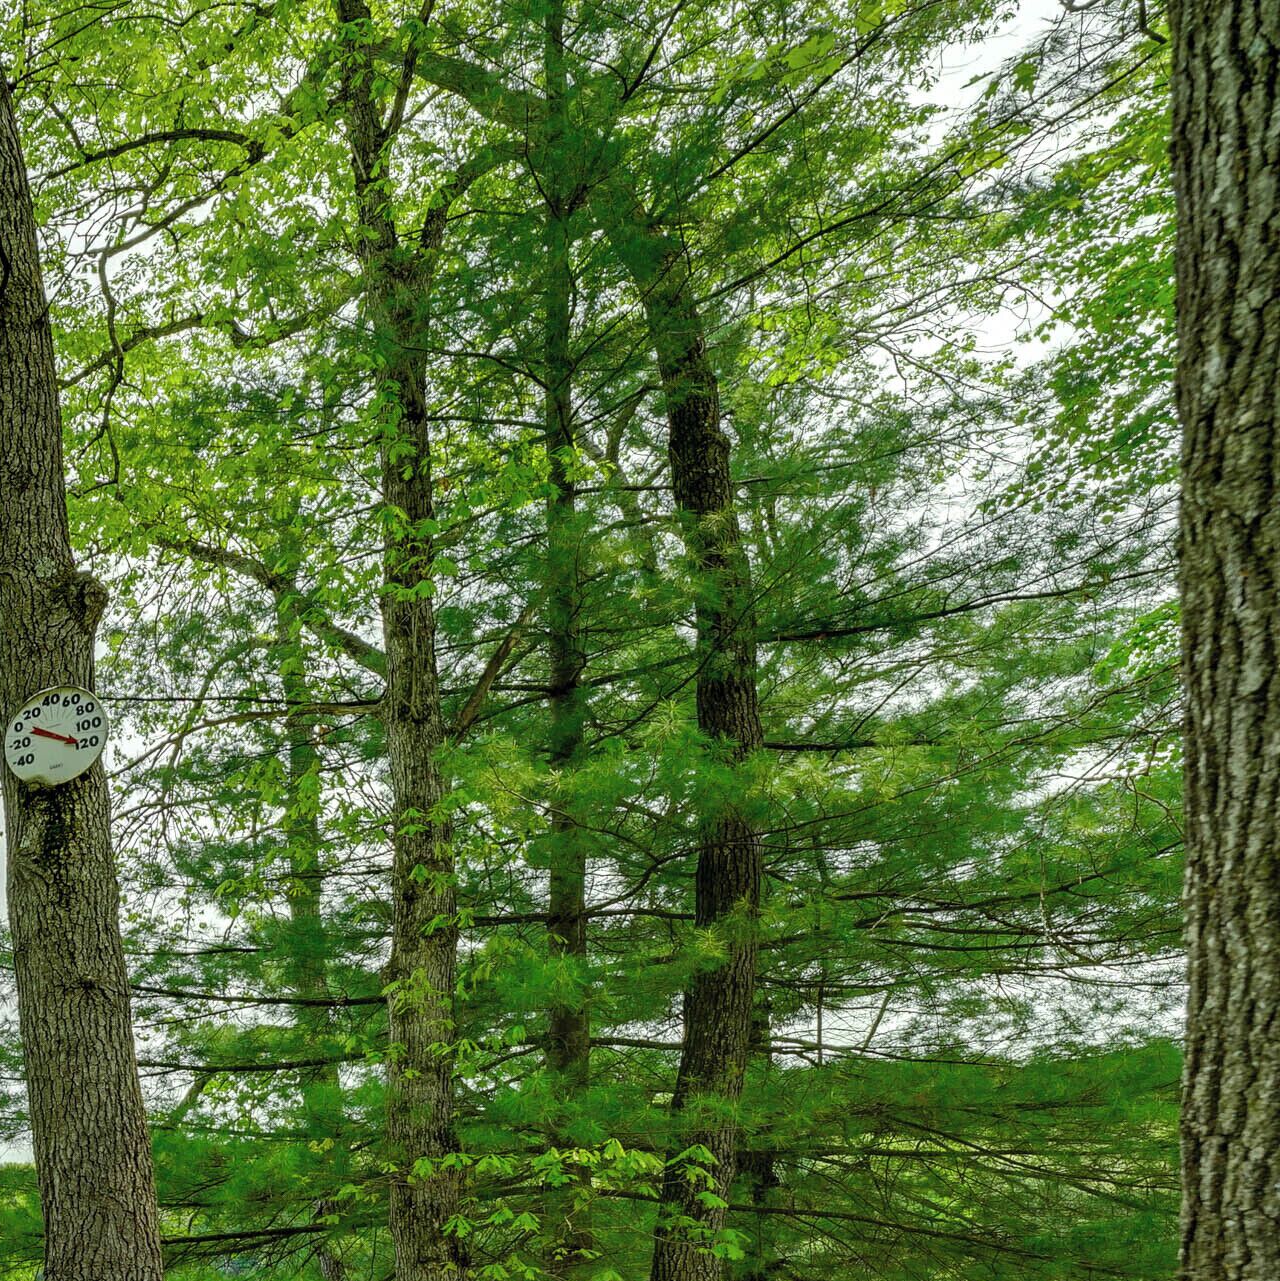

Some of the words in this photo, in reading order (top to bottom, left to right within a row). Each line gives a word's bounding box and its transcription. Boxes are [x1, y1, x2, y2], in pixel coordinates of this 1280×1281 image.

[42, 693, 60, 707] 40
[62, 693, 80, 707] 60
[23, 707, 41, 720] 20
[76, 702, 95, 716] 80
[14, 722, 23, 732] 0
[76, 716, 101, 732] 100
[9, 736, 31, 750] -20
[12, 753, 35, 767] -40
